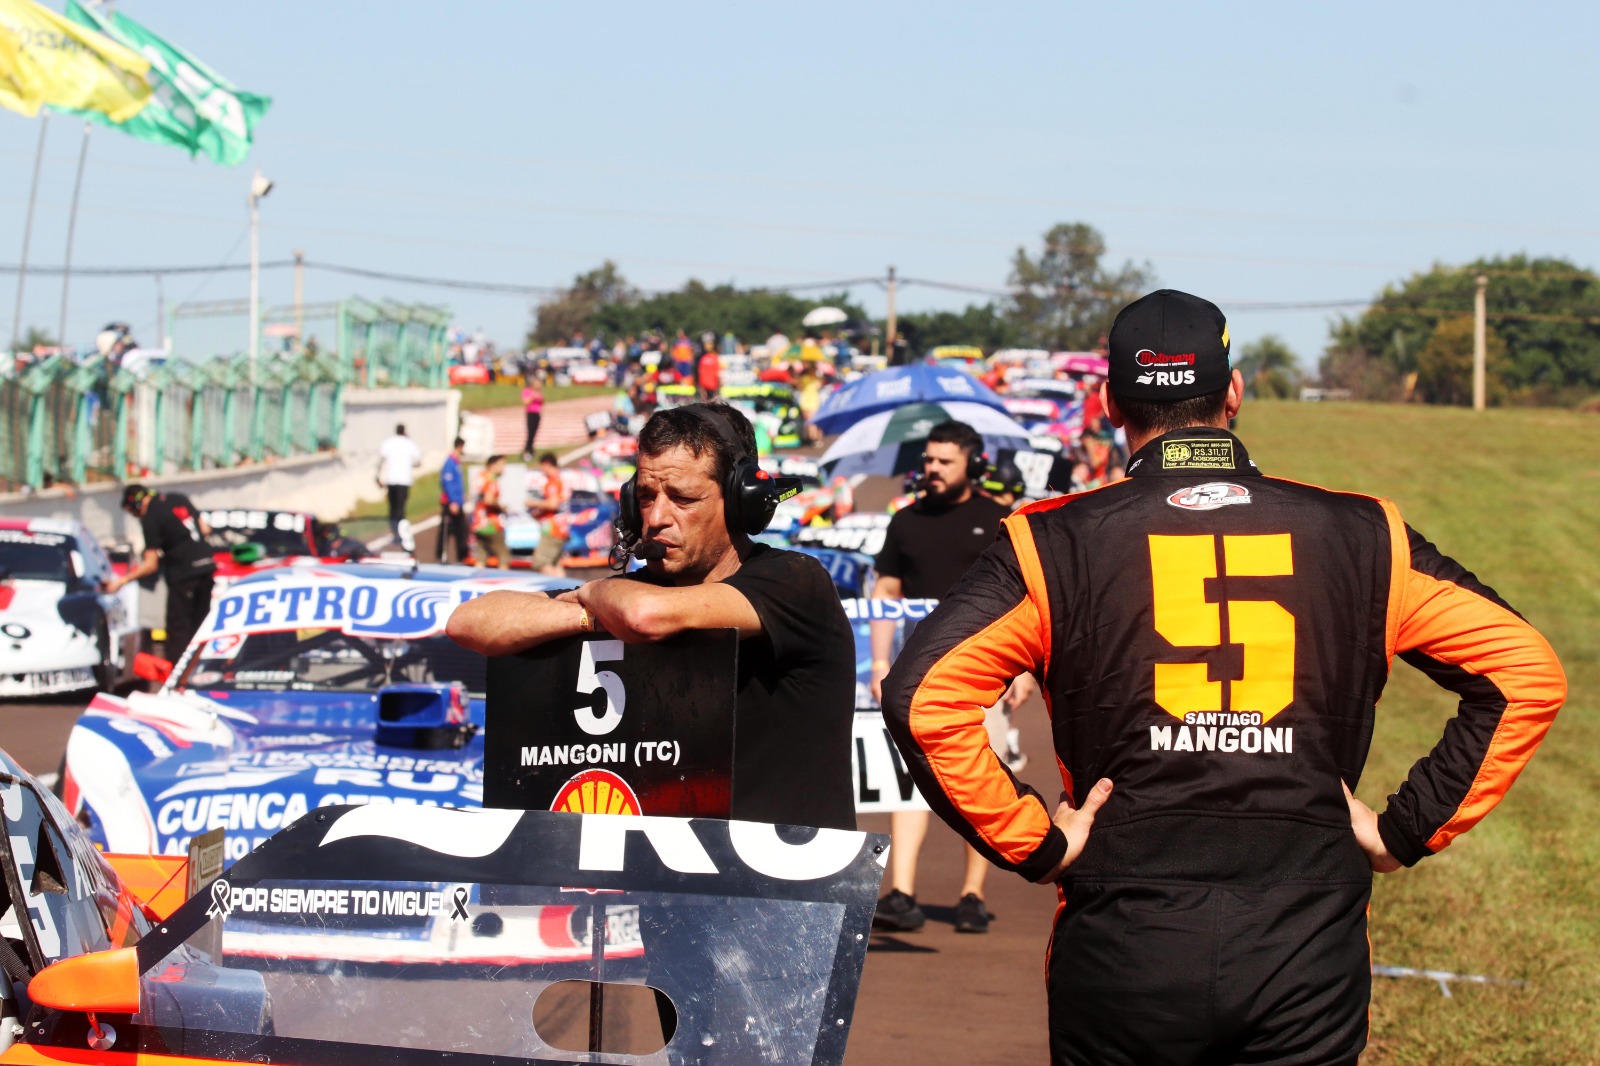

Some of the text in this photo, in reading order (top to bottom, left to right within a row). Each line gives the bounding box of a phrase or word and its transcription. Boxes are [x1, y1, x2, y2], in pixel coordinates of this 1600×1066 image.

[1156, 370, 1196, 385] RUS
[212, 585, 378, 632] PETRO
[1147, 532, 1296, 725] 5
[573, 639, 626, 735] 5
[1185, 711, 1262, 726] SANTIAGO
[520, 740, 681, 767] MANGONI (TC)
[1150, 725, 1294, 754] MANGONI
[157, 793, 308, 836] CUENCA
[230, 887, 450, 917] POR SIEMPRE TIO MIGUEL
